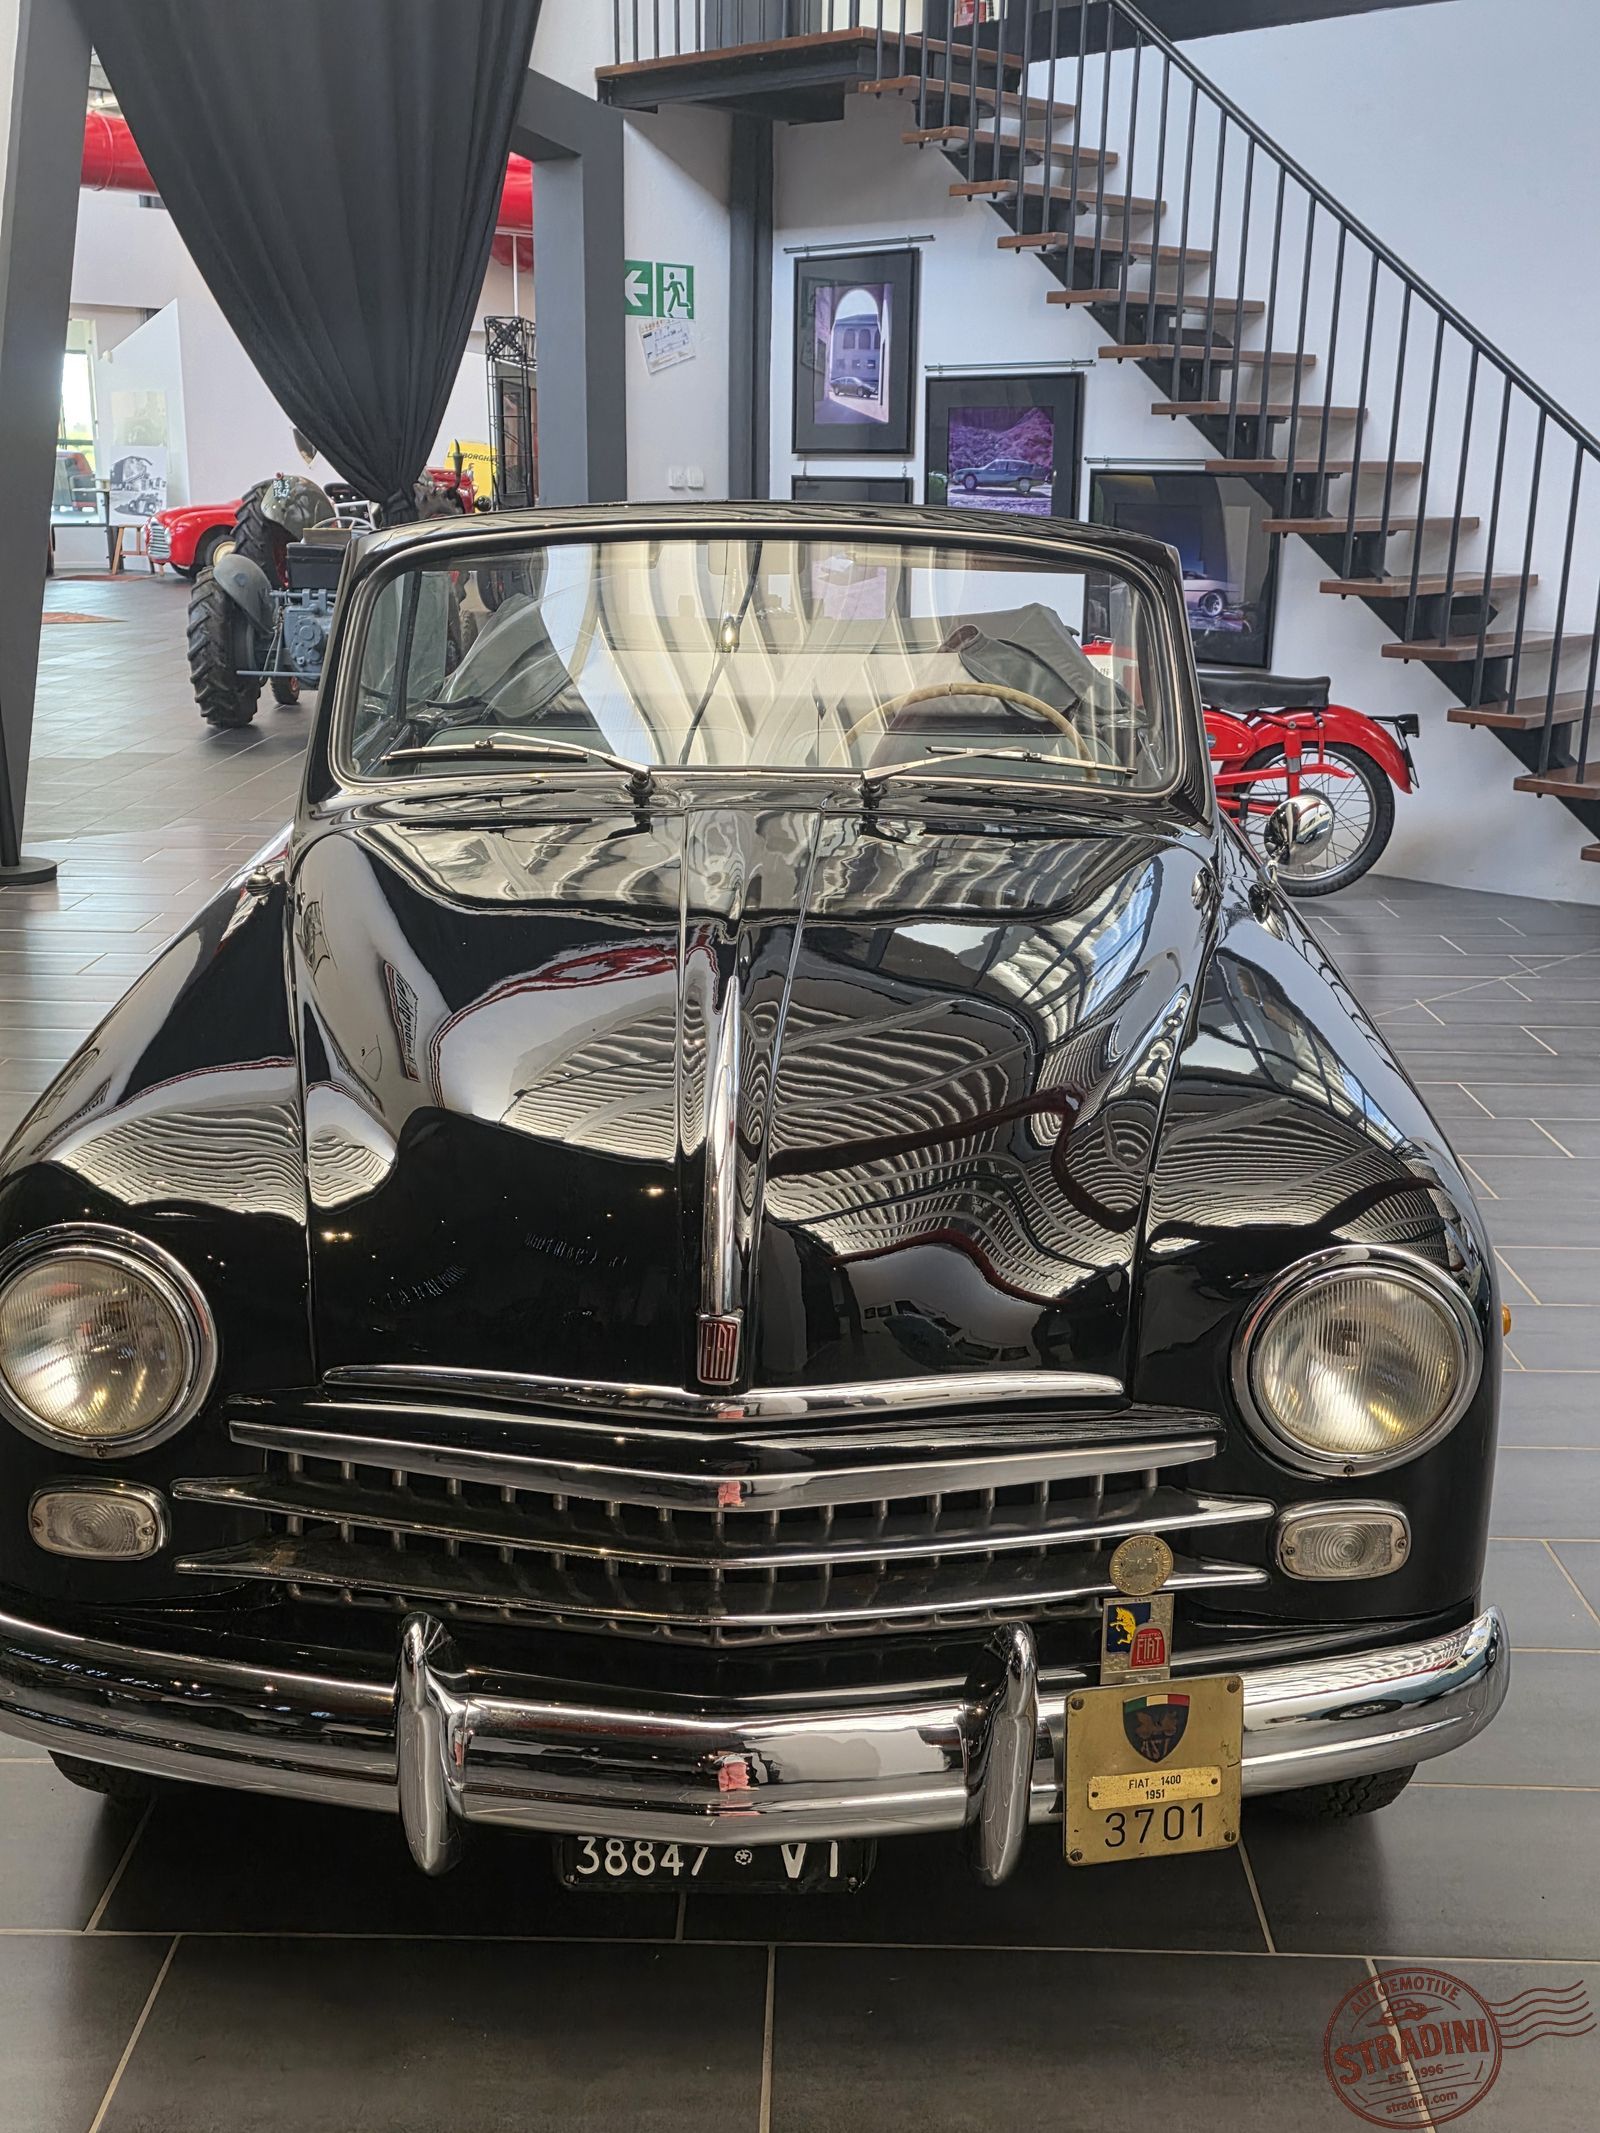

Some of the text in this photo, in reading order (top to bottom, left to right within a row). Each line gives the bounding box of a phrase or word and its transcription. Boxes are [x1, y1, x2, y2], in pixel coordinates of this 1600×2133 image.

[703, 1322, 736, 1380] FIAT
[1136, 1637, 1163, 1660] FIAT
[1128, 1774, 1182, 1790] FIAT 1400
[1145, 1789, 1166, 1800] 1951
[1104, 1802, 1204, 1848] 3701
